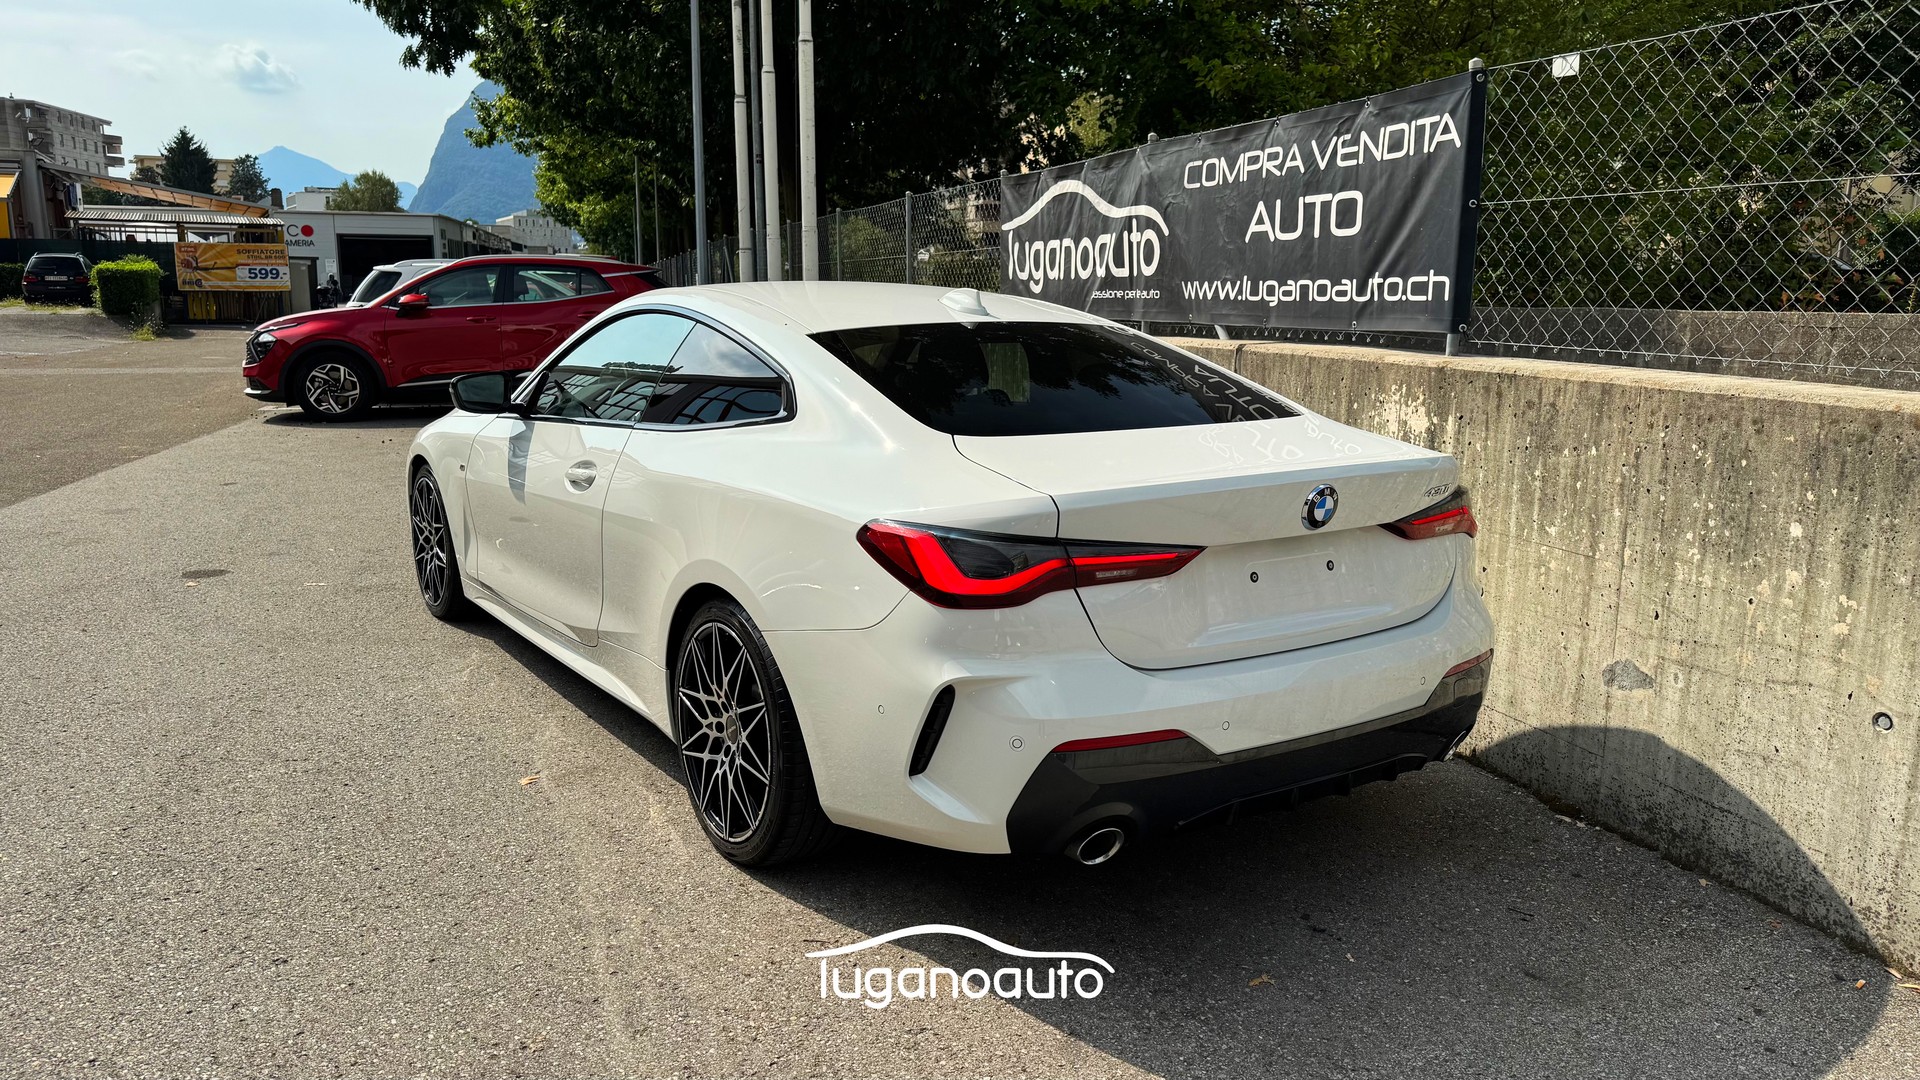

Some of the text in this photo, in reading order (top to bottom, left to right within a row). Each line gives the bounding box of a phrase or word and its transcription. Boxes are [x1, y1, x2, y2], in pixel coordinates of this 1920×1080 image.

[1184, 113, 1462, 190] COMPRA VENDITA
[1244, 190, 1364, 244] AUTO
[248, 267, 287, 280] 599.-
[1007, 217, 1162, 294] luganoauto
[1092, 289, 1124, 299] assione
[1181, 269, 1450, 307] www.luganoauto.ch
